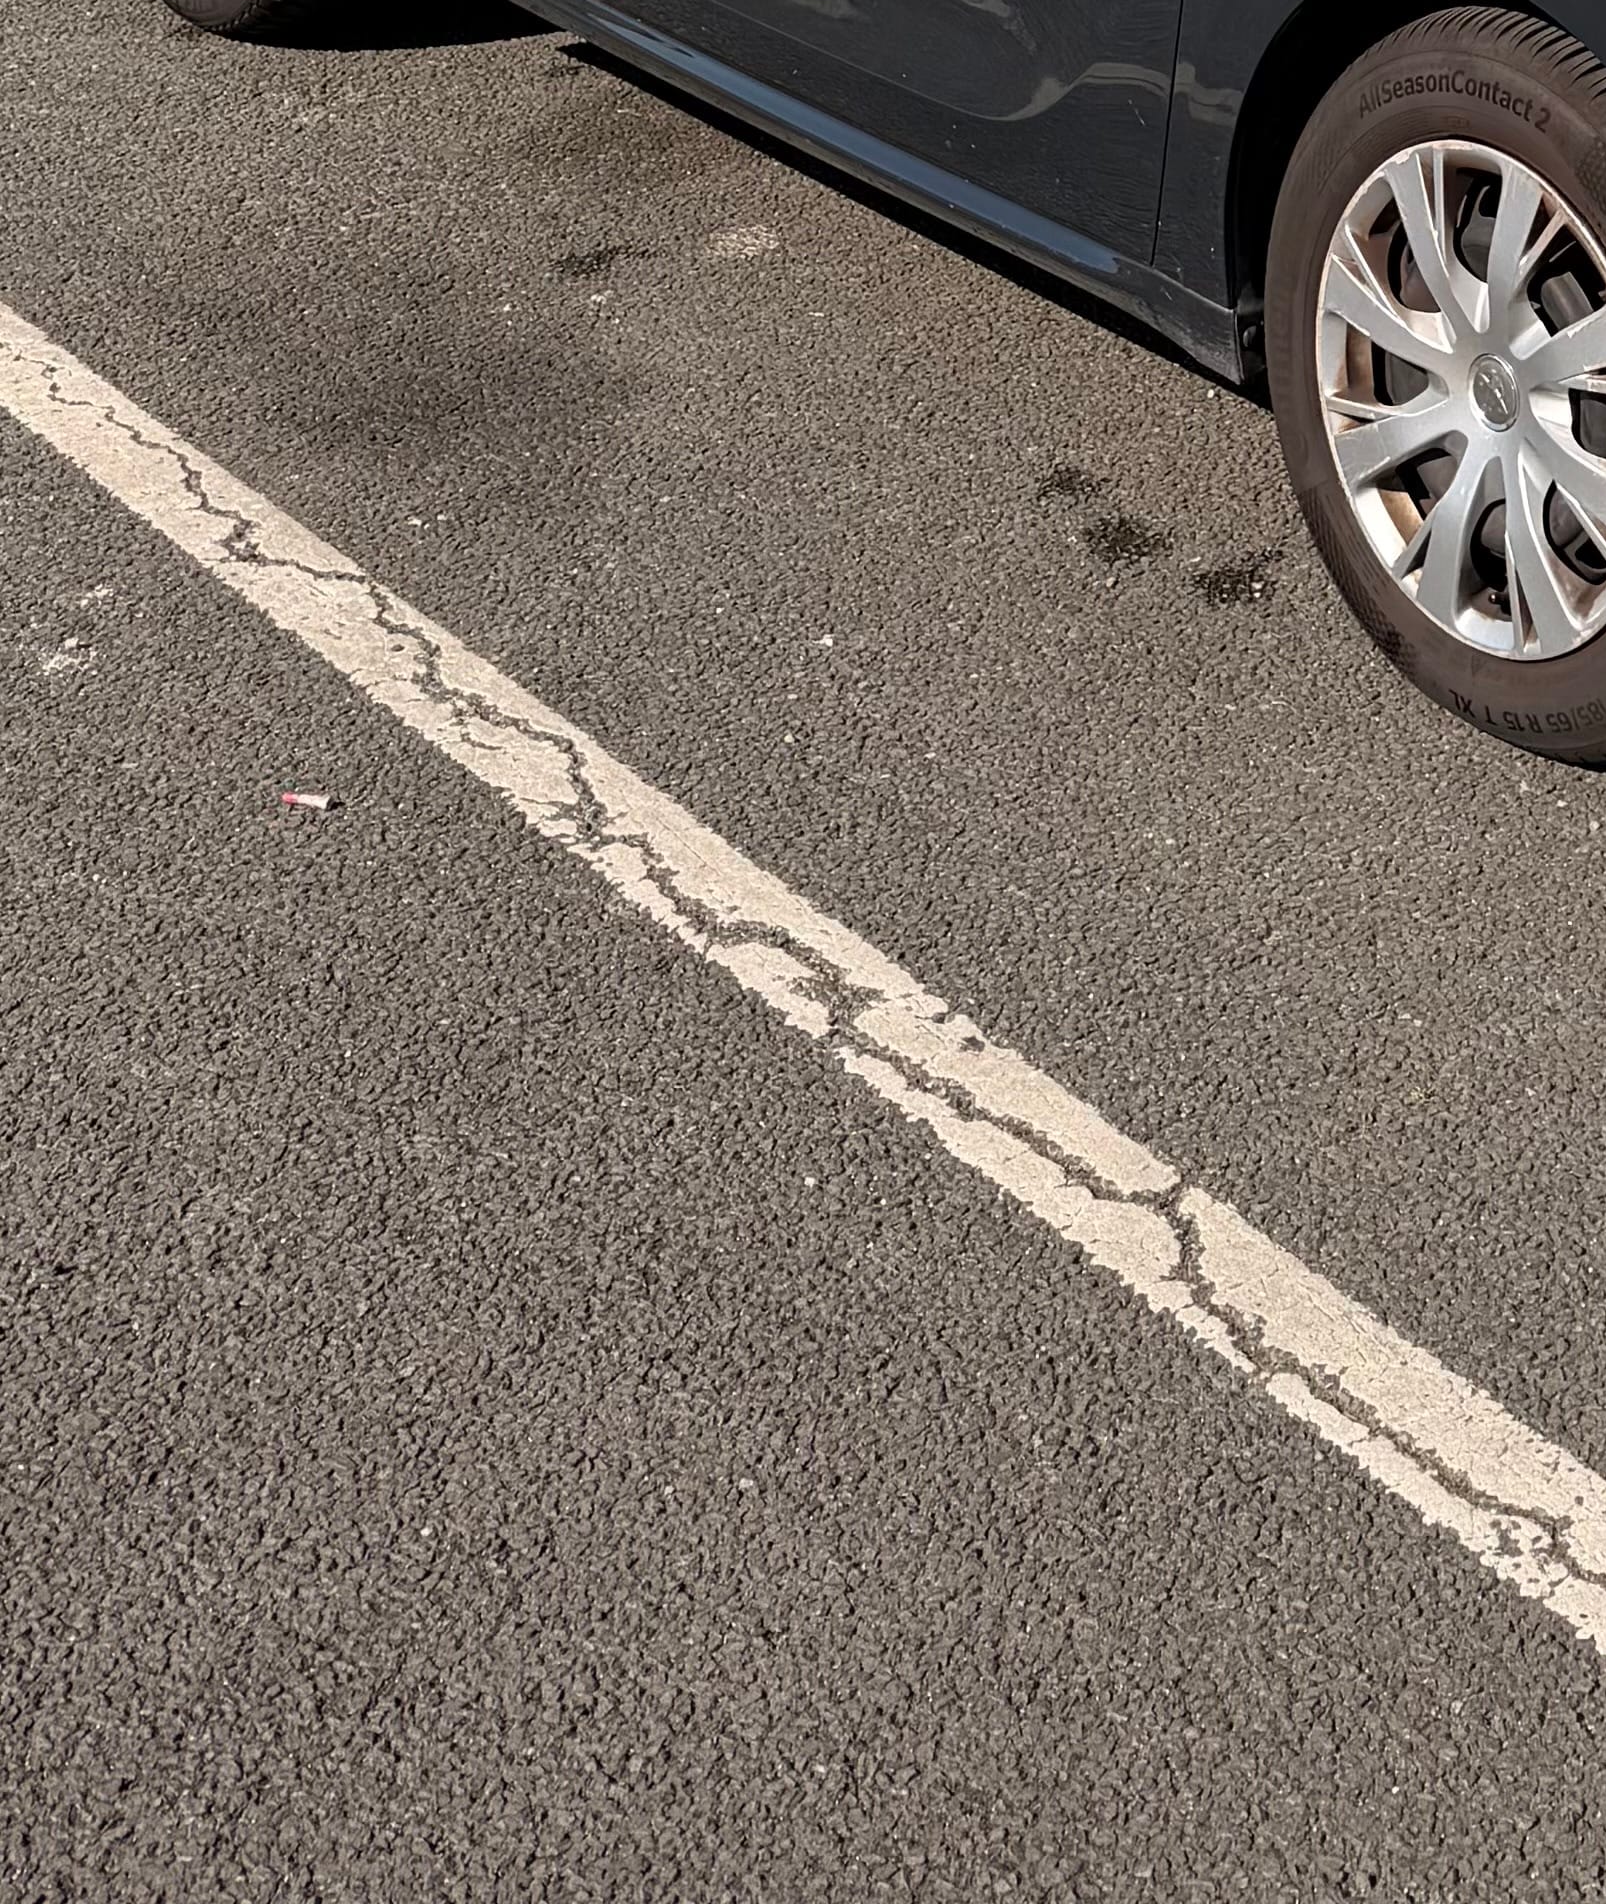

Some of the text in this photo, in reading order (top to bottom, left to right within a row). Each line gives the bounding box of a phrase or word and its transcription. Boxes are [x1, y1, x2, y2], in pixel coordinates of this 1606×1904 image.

[1359, 69, 1550, 134] AllSeasonContact 2
[1448, 689, 1476, 718] XL
